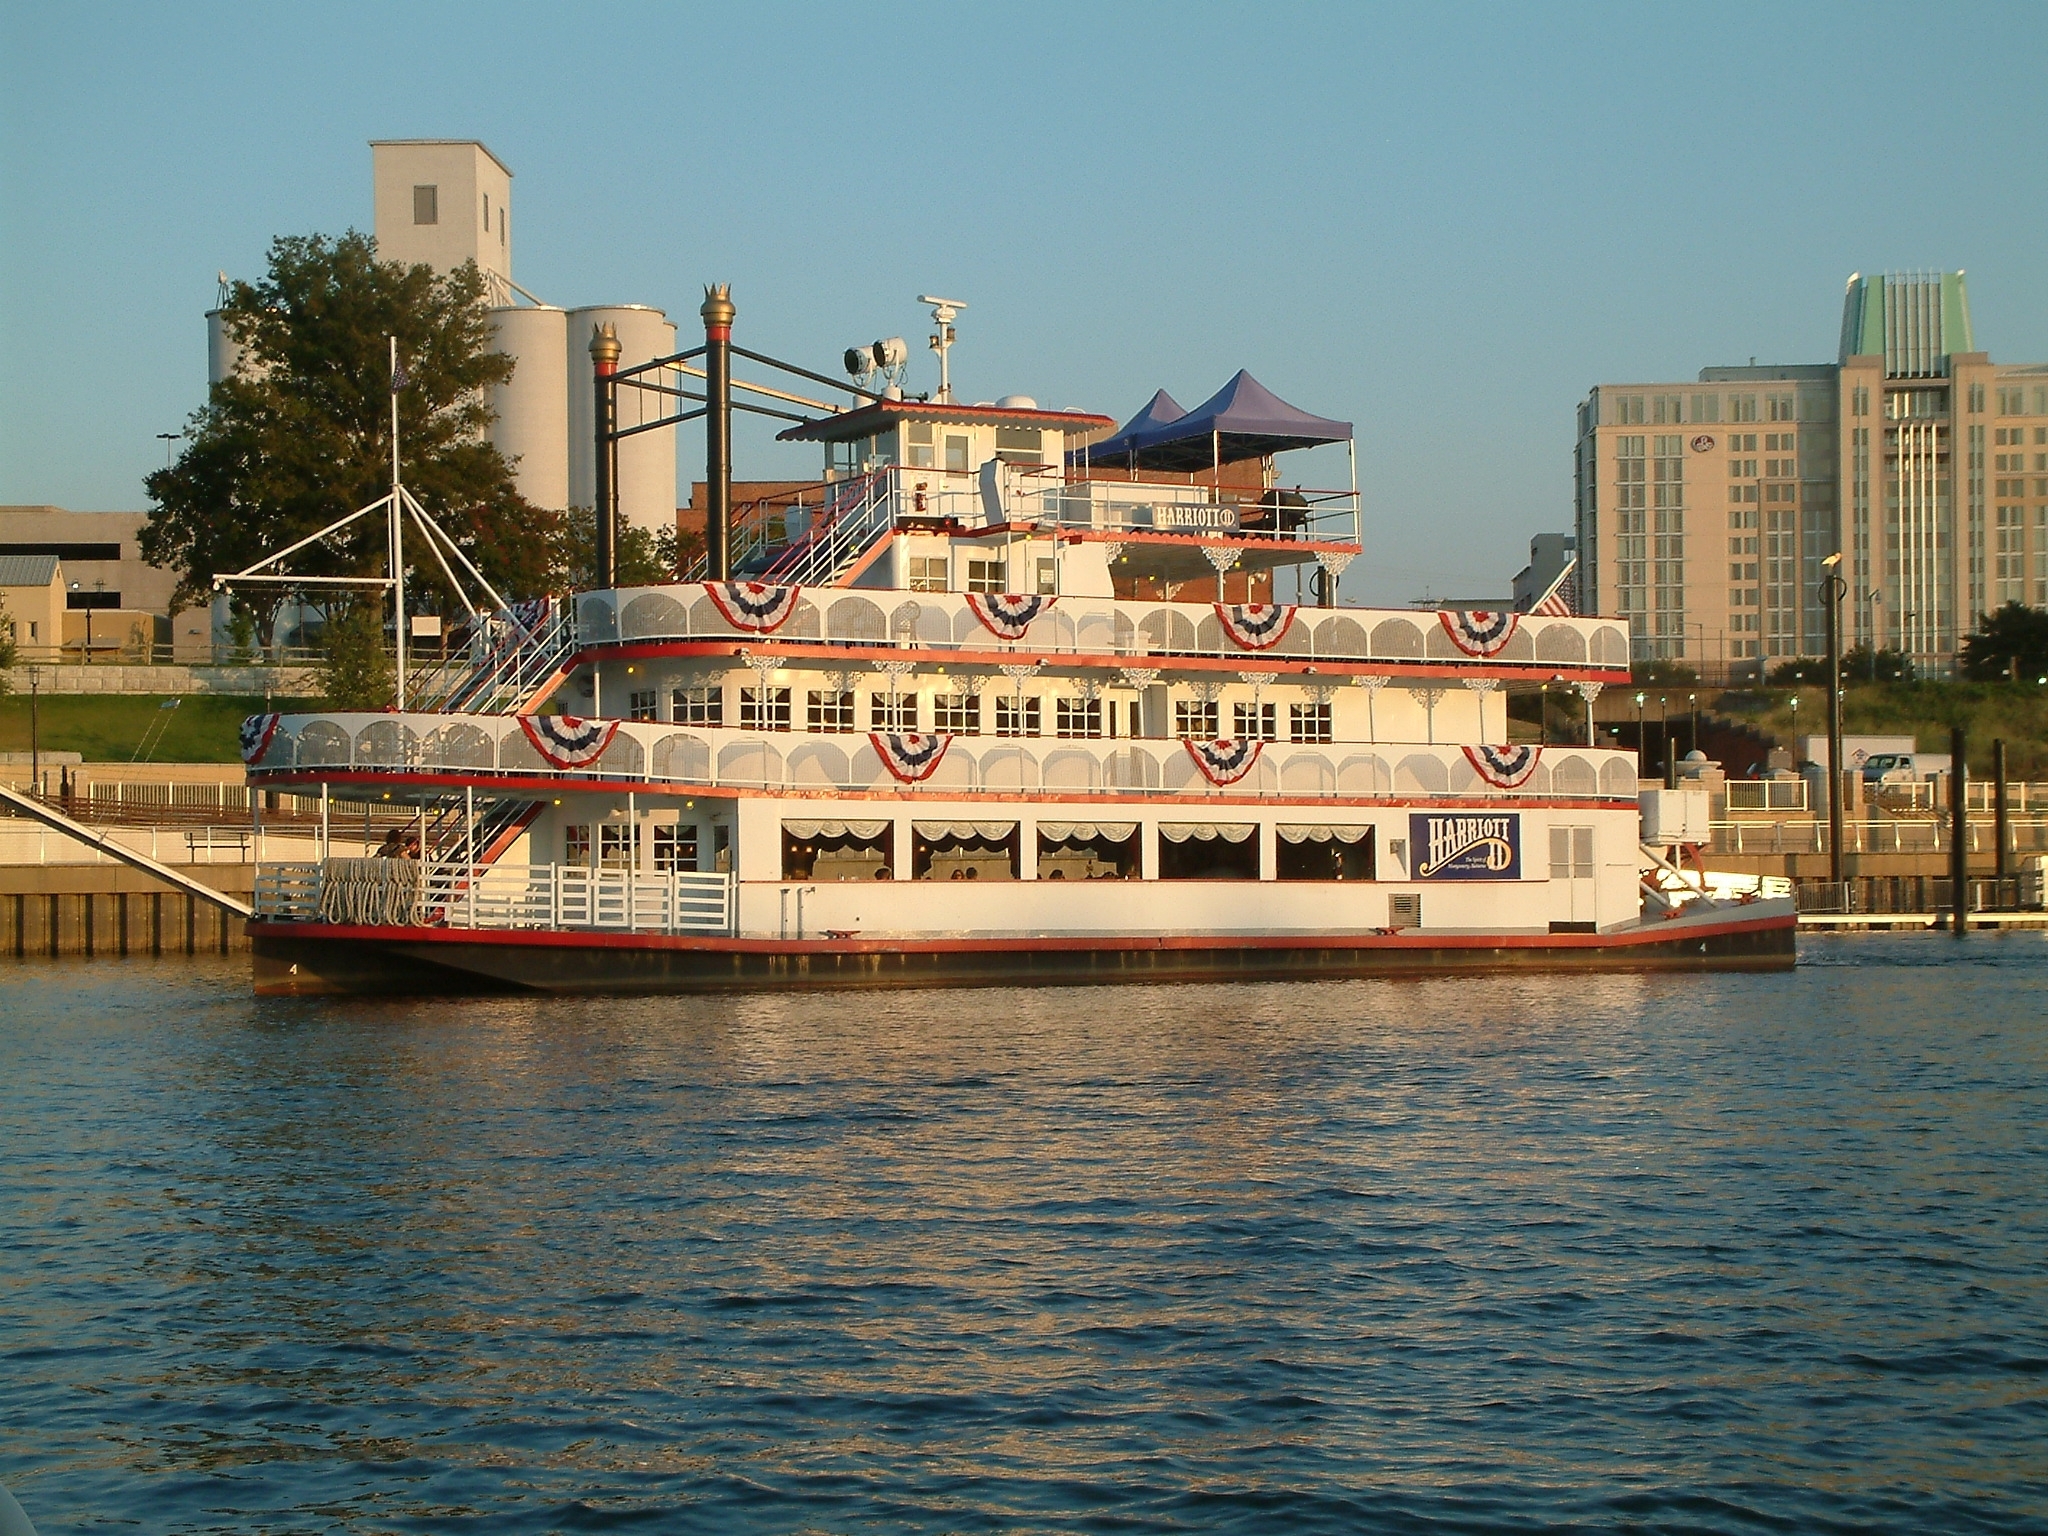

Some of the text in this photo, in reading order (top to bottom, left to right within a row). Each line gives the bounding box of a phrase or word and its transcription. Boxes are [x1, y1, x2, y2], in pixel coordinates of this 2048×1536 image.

[1157, 506, 1220, 527] HARRIOTT
[1427, 817, 1510, 870] HARRIOTT
[289, 963, 297, 975] 4
